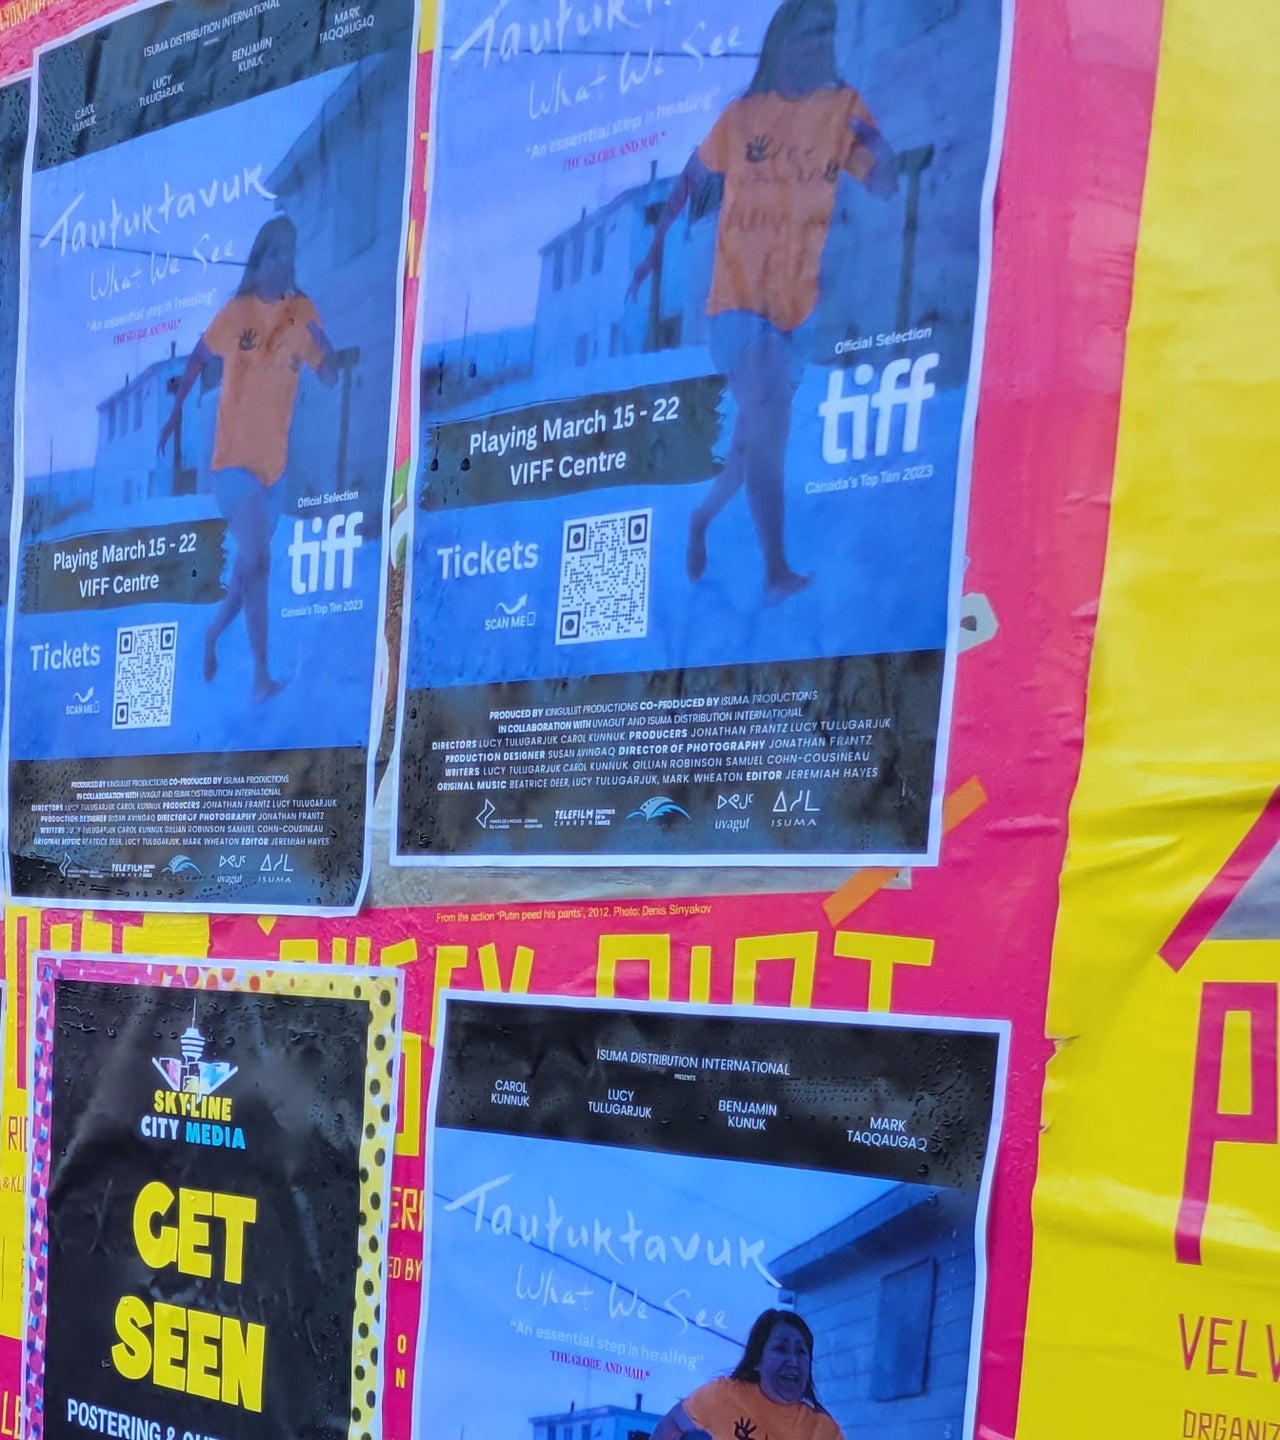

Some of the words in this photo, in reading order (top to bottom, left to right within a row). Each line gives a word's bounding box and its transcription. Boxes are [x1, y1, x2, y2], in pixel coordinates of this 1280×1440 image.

[144, 42, 168, 57] ISUMA
[170, 21, 221, 48] DISTRIBUTION
[222, 0, 280, 29] INTERNATIONAL
[835, 336, 872, 354] Official
[876, 327, 932, 346] Selection
[818, 352, 940, 464] tiff
[469, 421, 538, 461] Playing
[543, 409, 607, 442] March
[611, 403, 636, 431] 15
[652, 396, 680, 425] 22
[509, 456, 555, 487] VIFF
[559, 448, 626, 480] Centre
[805, 477, 858, 494] Canada's
[861, 474, 878, 487] Top
[881, 472, 899, 483] Ten
[903, 464, 934, 480] 2023
[288, 511, 364, 595] tiff
[437, 539, 538, 581] Tickets
[79, 576, 109, 598] VIFF
[113, 571, 159, 593] Centre
[30, 641, 101, 671] Tickets
[436, 913, 455, 923] From
[458, 912, 469, 921] the
[470, 911, 494, 921] action
[521, 909, 541, 921] peed
[544, 908, 556, 919] his
[614, 906, 640, 917] Photo:
[642, 905, 666, 915] Denis
[669, 904, 711, 915] Sinyakov
[596, 1049, 627, 1065] ISUMA
[630, 1050, 698, 1070] DISTRIBUTION
[702, 1057, 790, 1076] INTERNATIONAL
[491, 1092, 530, 1108] KUNNUK
[494, 1079, 528, 1094] CAROL
[607, 1088, 635, 1103] LUCY
[154, 1089, 232, 1122] SKYLINE
[587, 1101, 652, 1119] TULUGARJUK
[719, 1100, 777, 1117] BENJAMIN
[141, 1115, 178, 1140] CITY
[185, 1122, 246, 1150] MEDIA
[727, 1115, 766, 1132] KUNUK
[869, 1117, 906, 1133] MARK
[846, 1130, 927, 1153] TAQQAUGAQ
[133, 1181, 257, 1284] GET
[515, 1263, 594, 1311] What
[609, 1283, 648, 1321] We
[663, 1289, 729, 1337] See
[111, 1295, 267, 1413] SEEN
[536, 1326, 595, 1348] essential
[598, 1337, 626, 1356] step
[628, 1342, 638, 1356] in
